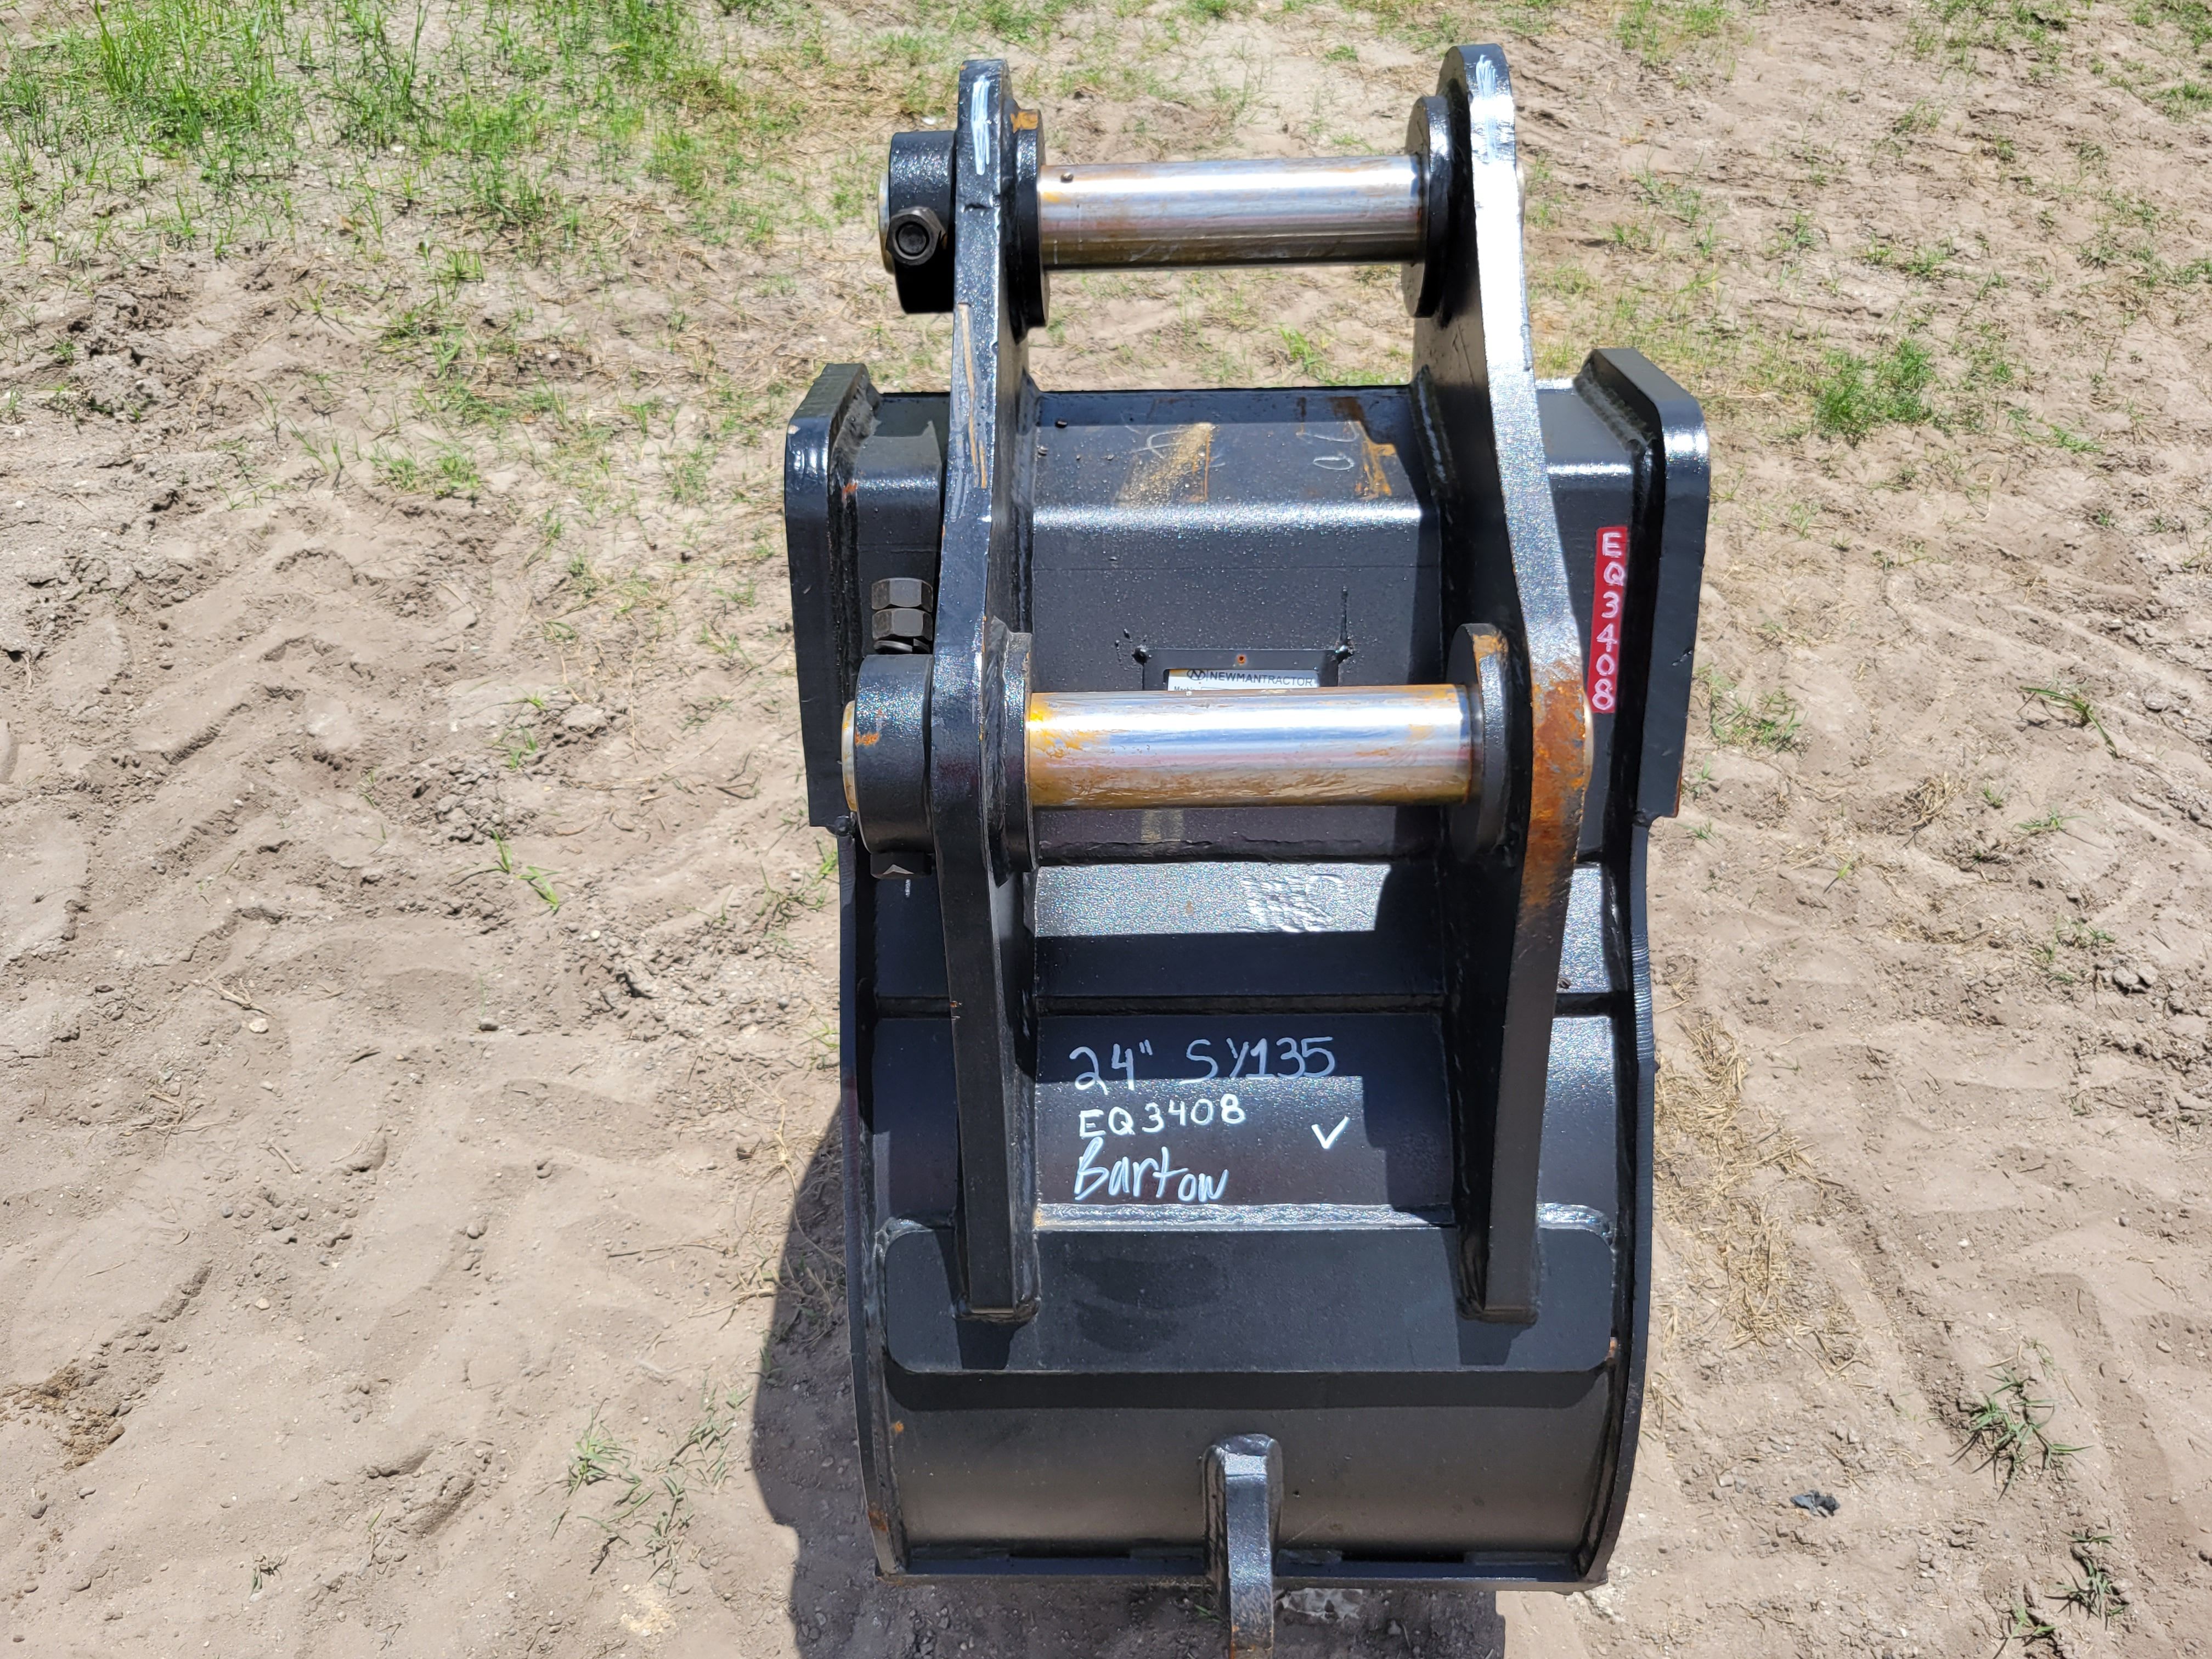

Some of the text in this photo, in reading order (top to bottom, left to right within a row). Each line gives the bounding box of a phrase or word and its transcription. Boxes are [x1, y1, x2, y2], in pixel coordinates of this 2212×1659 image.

[1592, 532, 1626, 711] EQ3408
[1069, 1036, 1336, 1095] 24" SY135
[1079, 1093, 1246, 1138] EQ3408
